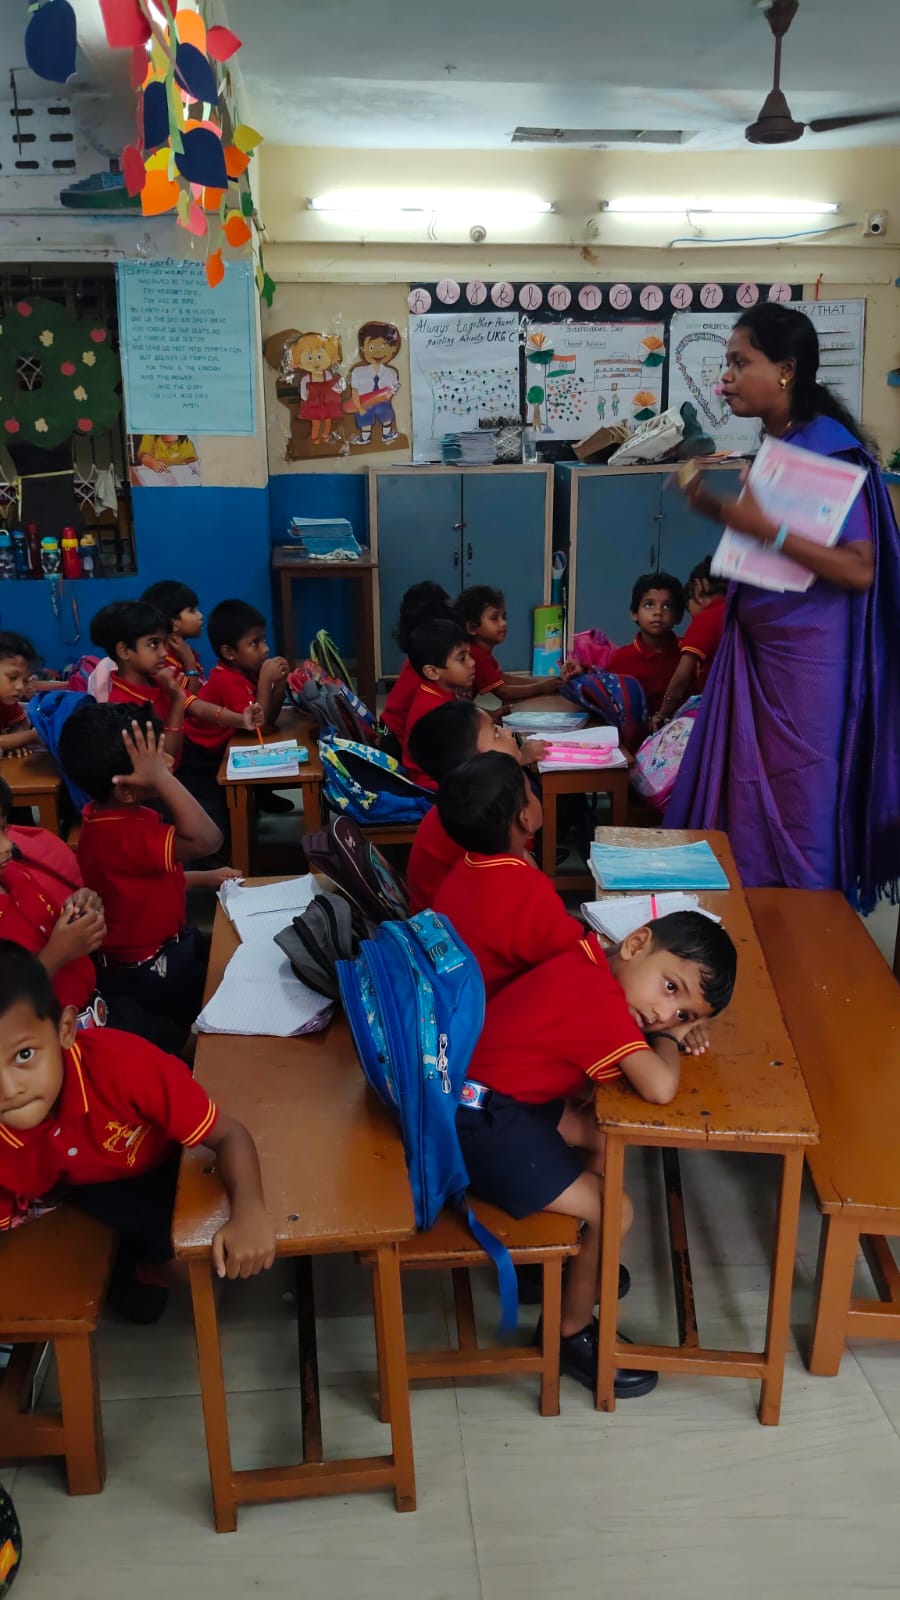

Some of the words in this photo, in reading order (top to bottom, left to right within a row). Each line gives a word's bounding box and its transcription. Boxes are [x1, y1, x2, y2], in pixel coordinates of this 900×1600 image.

[413, 319, 449, 337] Always
[457, 316, 493, 334] together
[486, 331, 507, 342] UKG
